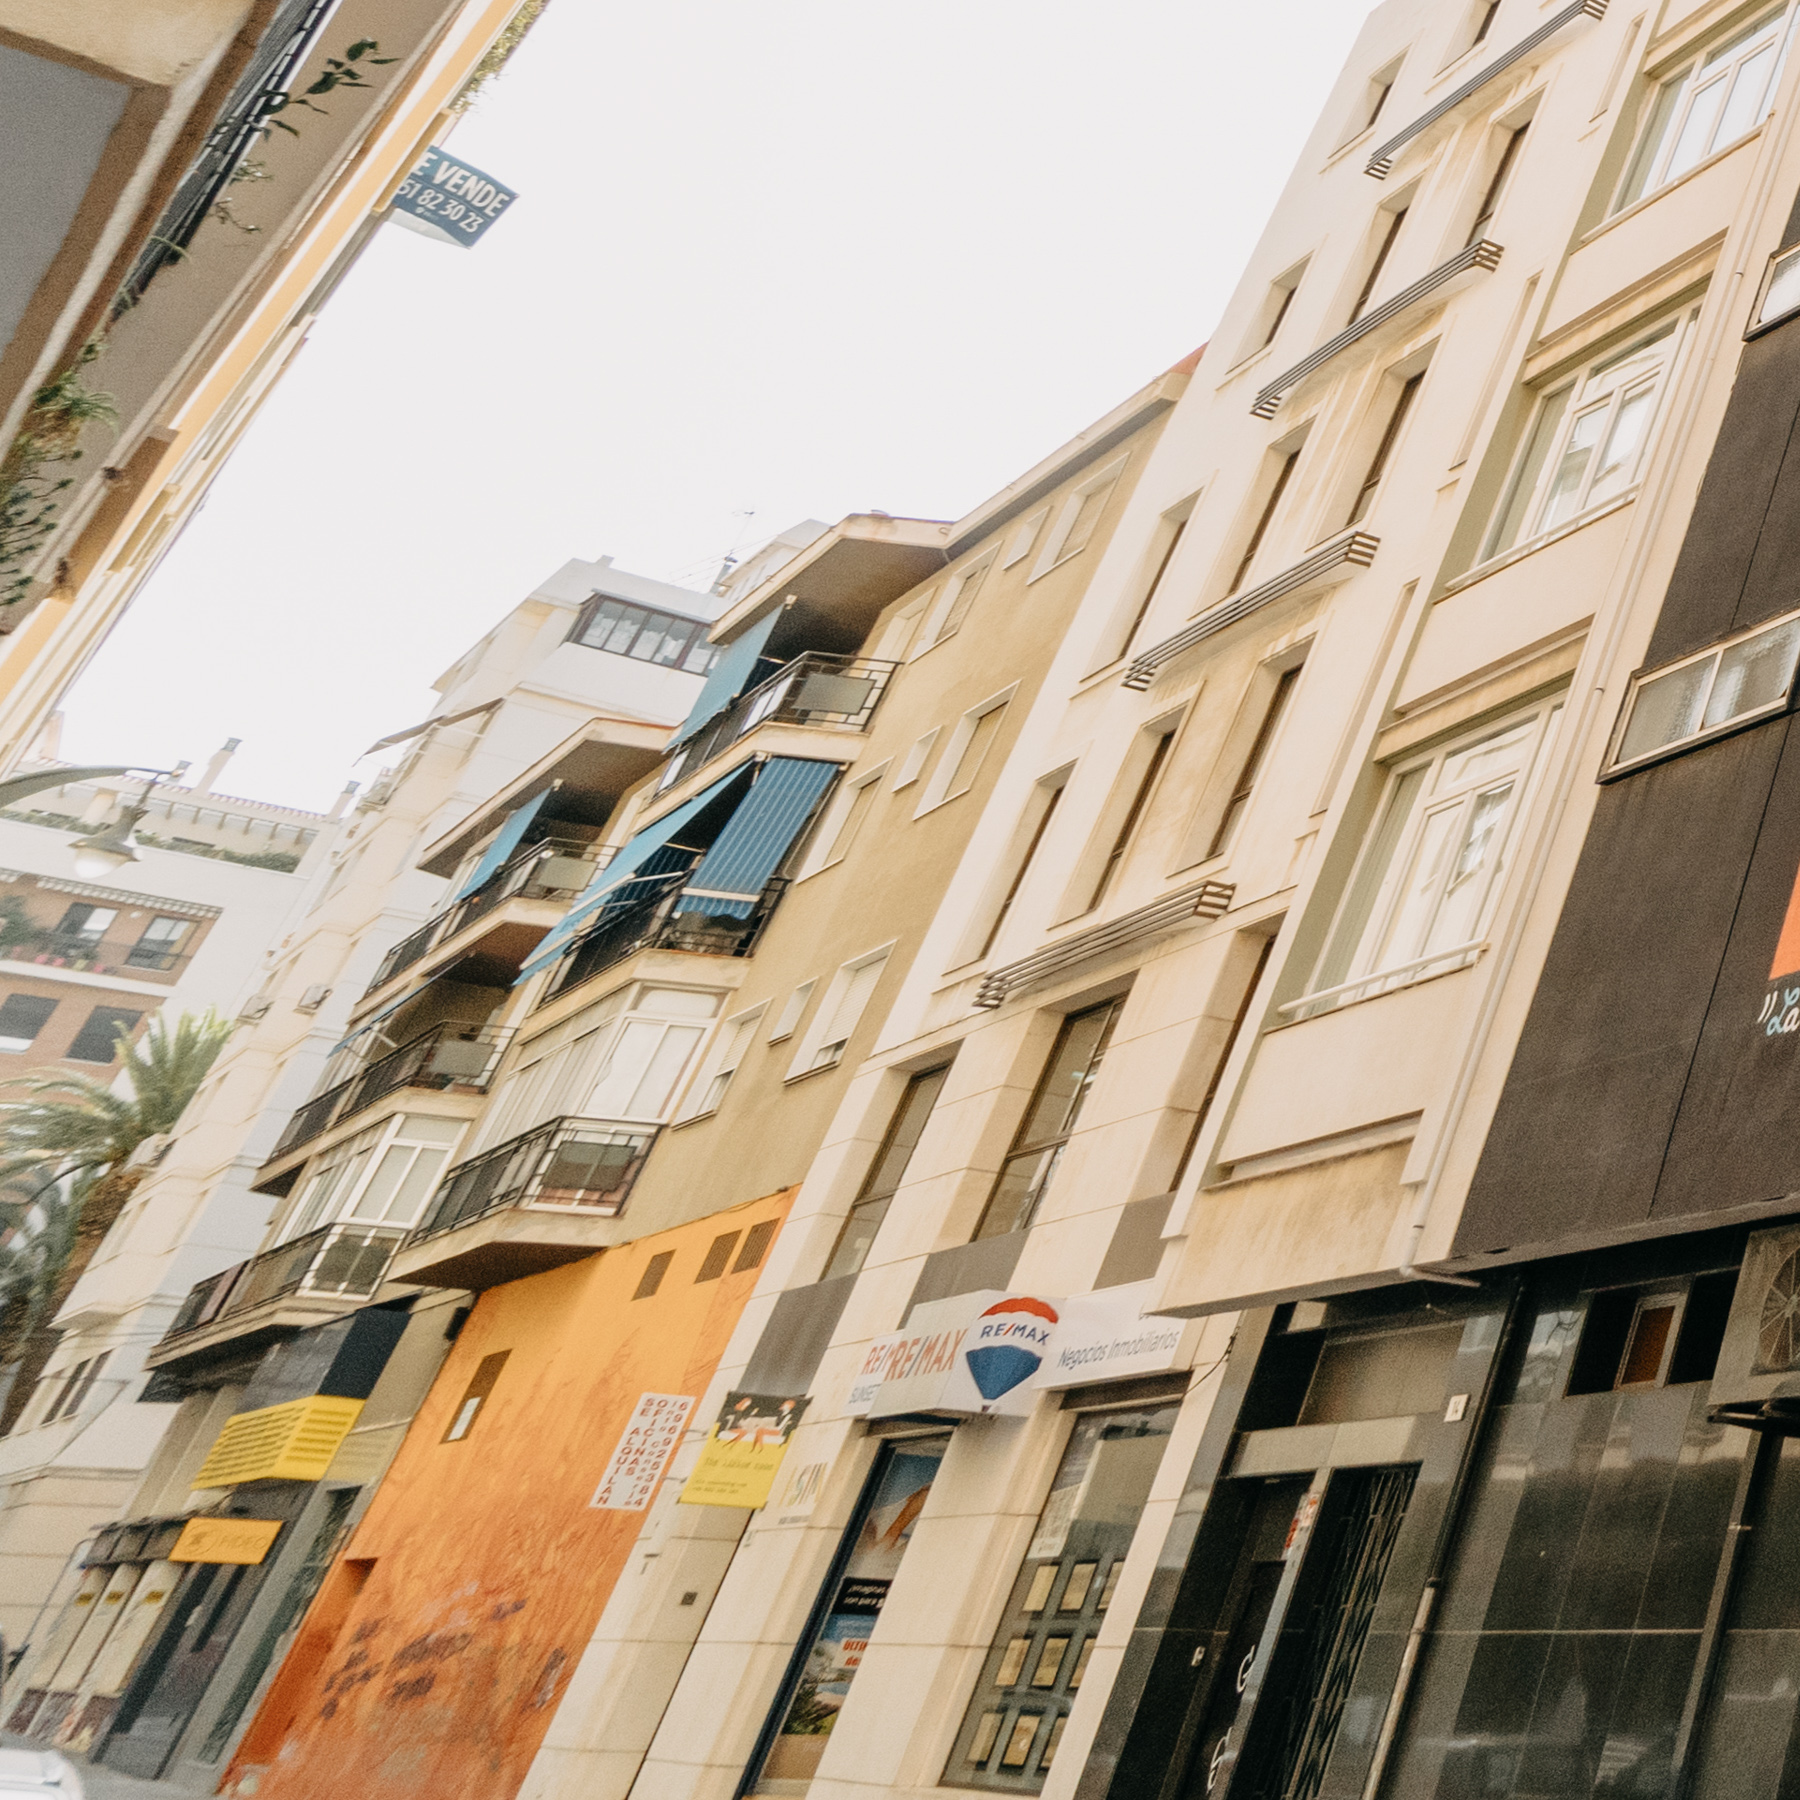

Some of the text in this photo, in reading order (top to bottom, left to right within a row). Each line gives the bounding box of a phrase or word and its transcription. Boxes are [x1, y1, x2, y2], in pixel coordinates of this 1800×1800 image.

[399, 177, 422, 201] 51
[419, 188, 441, 211] 82
[440, 200, 465, 222] 30
[460, 211, 484, 233] 23
[410, 152, 510, 218] E VENDE
[884, 1328, 969, 1381] RE/MAX
[979, 1322, 1051, 1346] RE/MAX
[1056, 1327, 1180, 1371] Negocios Inmobiliarios
[640, 1398, 656, 1417] SE
[625, 1399, 668, 1477] OFICINAS
